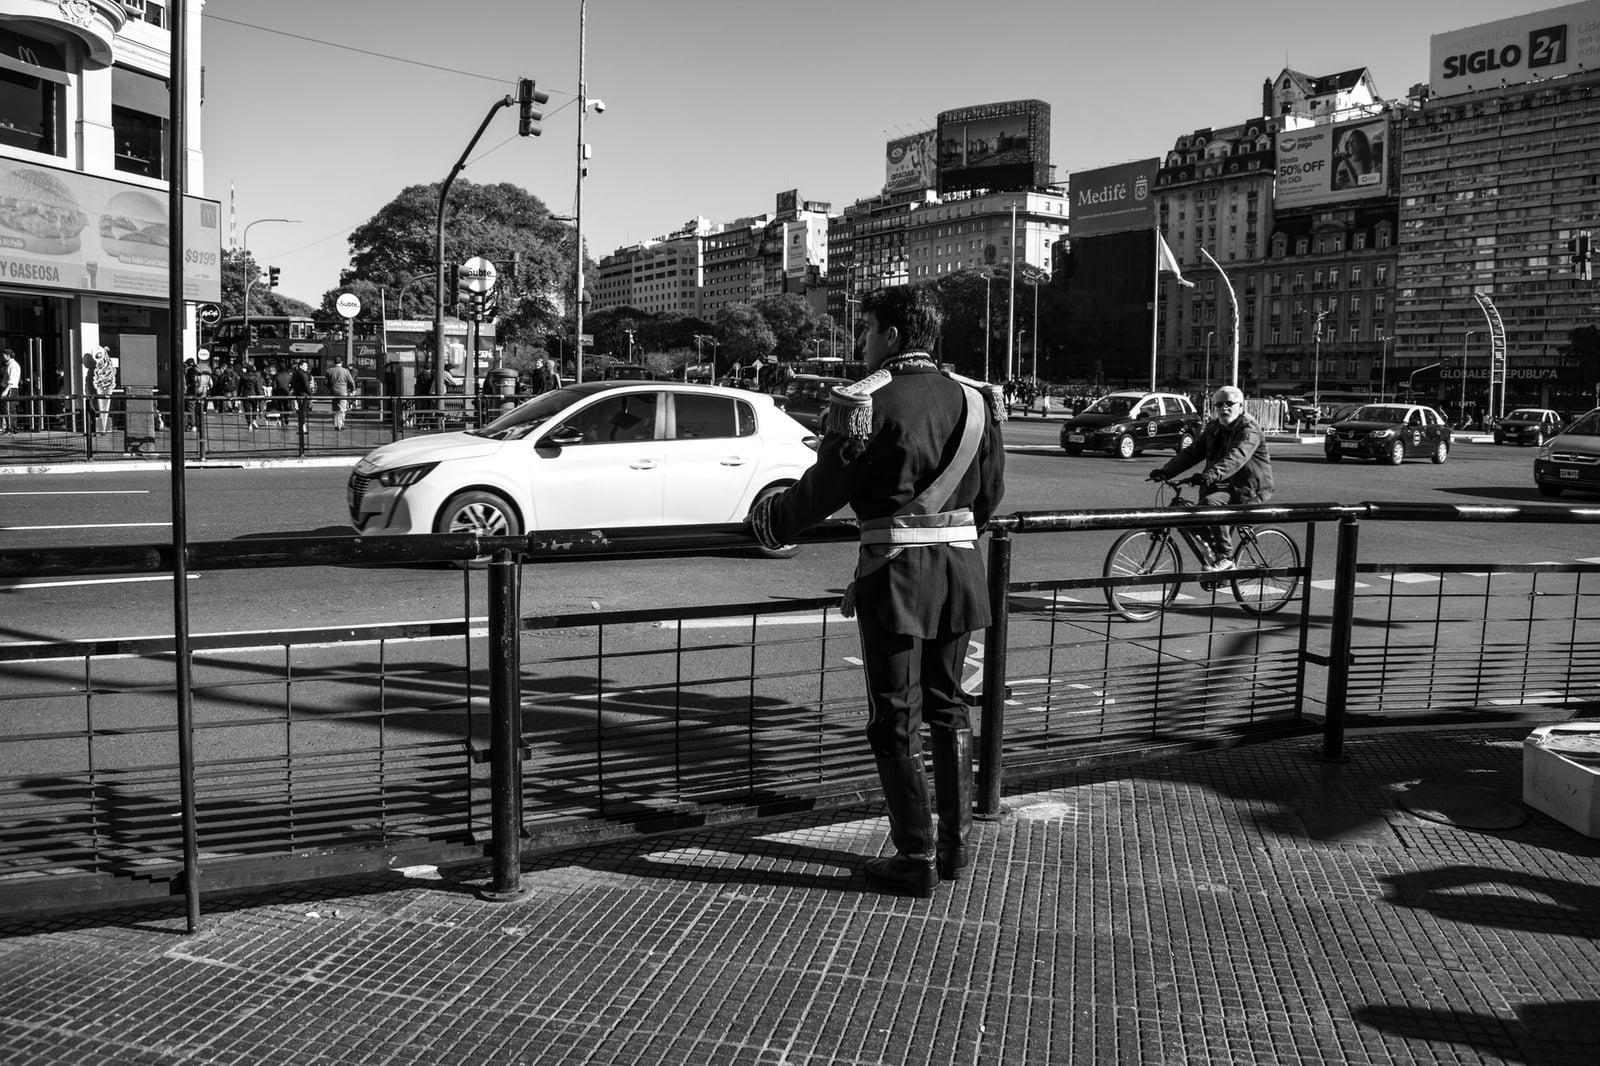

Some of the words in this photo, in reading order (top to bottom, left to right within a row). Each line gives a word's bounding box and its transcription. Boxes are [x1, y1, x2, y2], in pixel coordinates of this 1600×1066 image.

[1443, 44, 1521, 79] SIGLO
[1533, 35, 1561, 64] 21
[1297, 134, 1324, 143] mercado
[1297, 142, 1312, 150] pago
[891, 170, 915, 180] GRACIAS
[1280, 164, 1302, 177] 50%
[1303, 160, 1325, 173] OFF
[1077, 183, 1127, 206] Medifé
[185, 249, 216, 265] $9199
[10, 262, 60, 282] GASEOSA
[340, 300, 358, 308] Subte
[1504, 367, 1558, 379] EPÚBLICA
